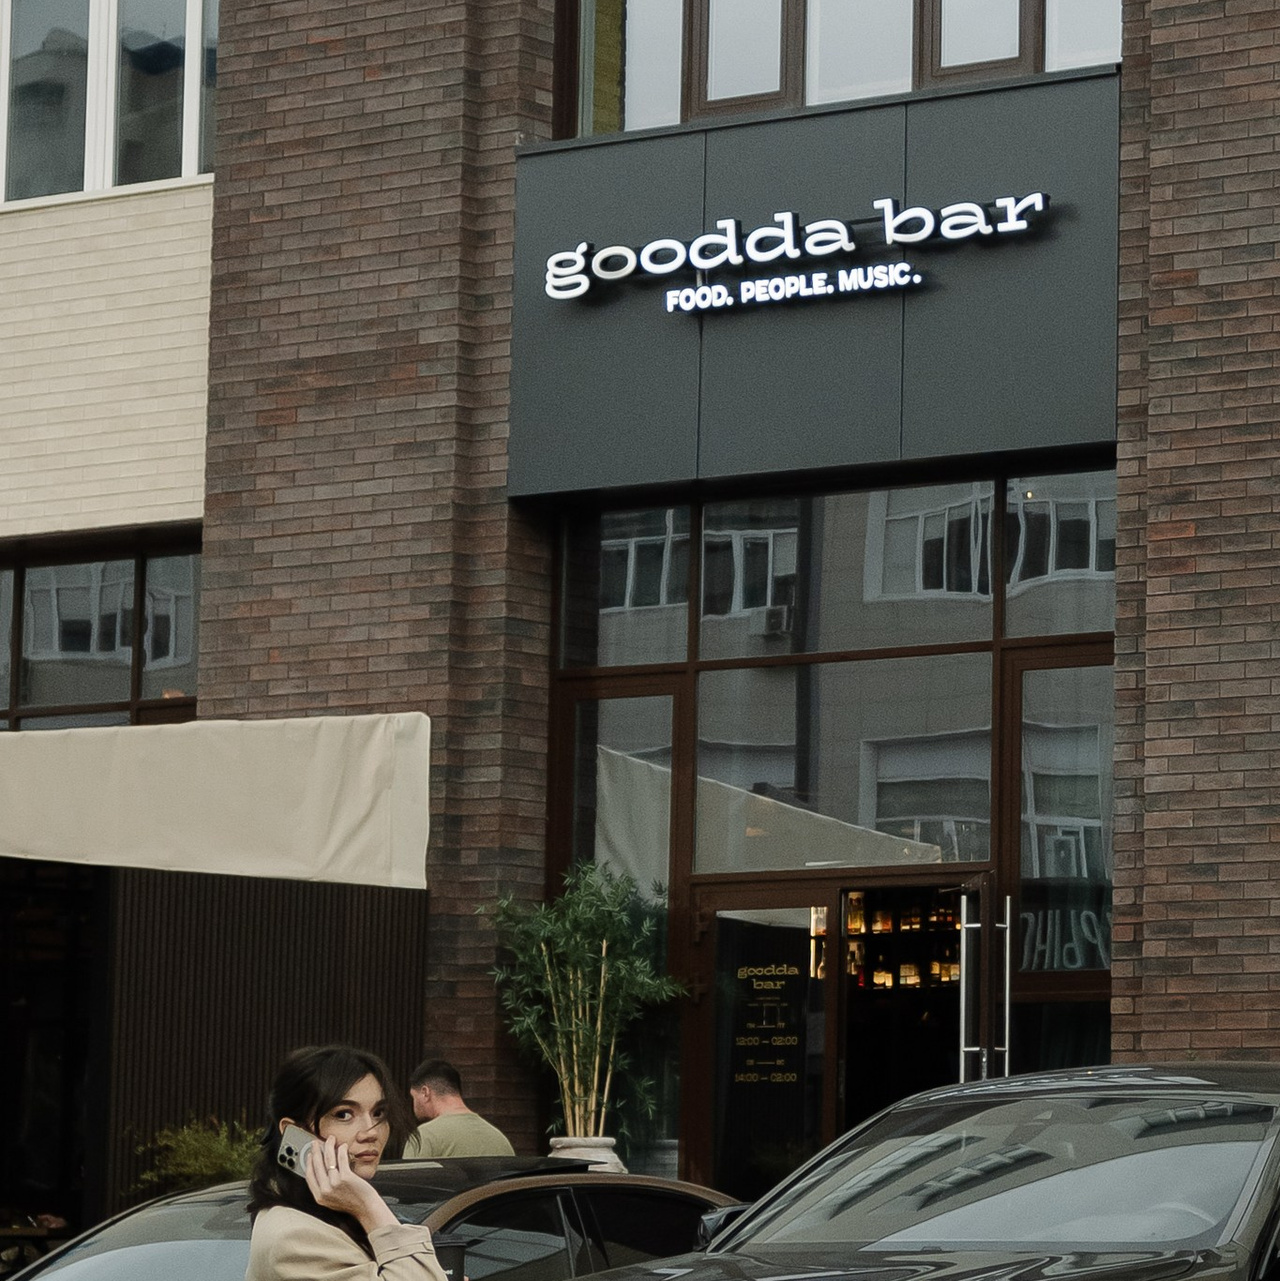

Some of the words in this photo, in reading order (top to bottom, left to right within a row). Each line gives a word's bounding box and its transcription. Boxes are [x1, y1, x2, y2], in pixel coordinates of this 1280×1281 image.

[544, 211, 856, 301] goodda
[872, 191, 1049, 245] bar
[665, 284, 734, 313] FOOD.
[740, 271, 835, 304] PEOPLE.
[837, 261, 922, 291] MUSIC.
[737, 964, 799, 979] goodda
[751, 978, 786, 990] bar
[770, 1036, 798, 1046] 02:00
[770, 1072, 797, 1082] 02:00
